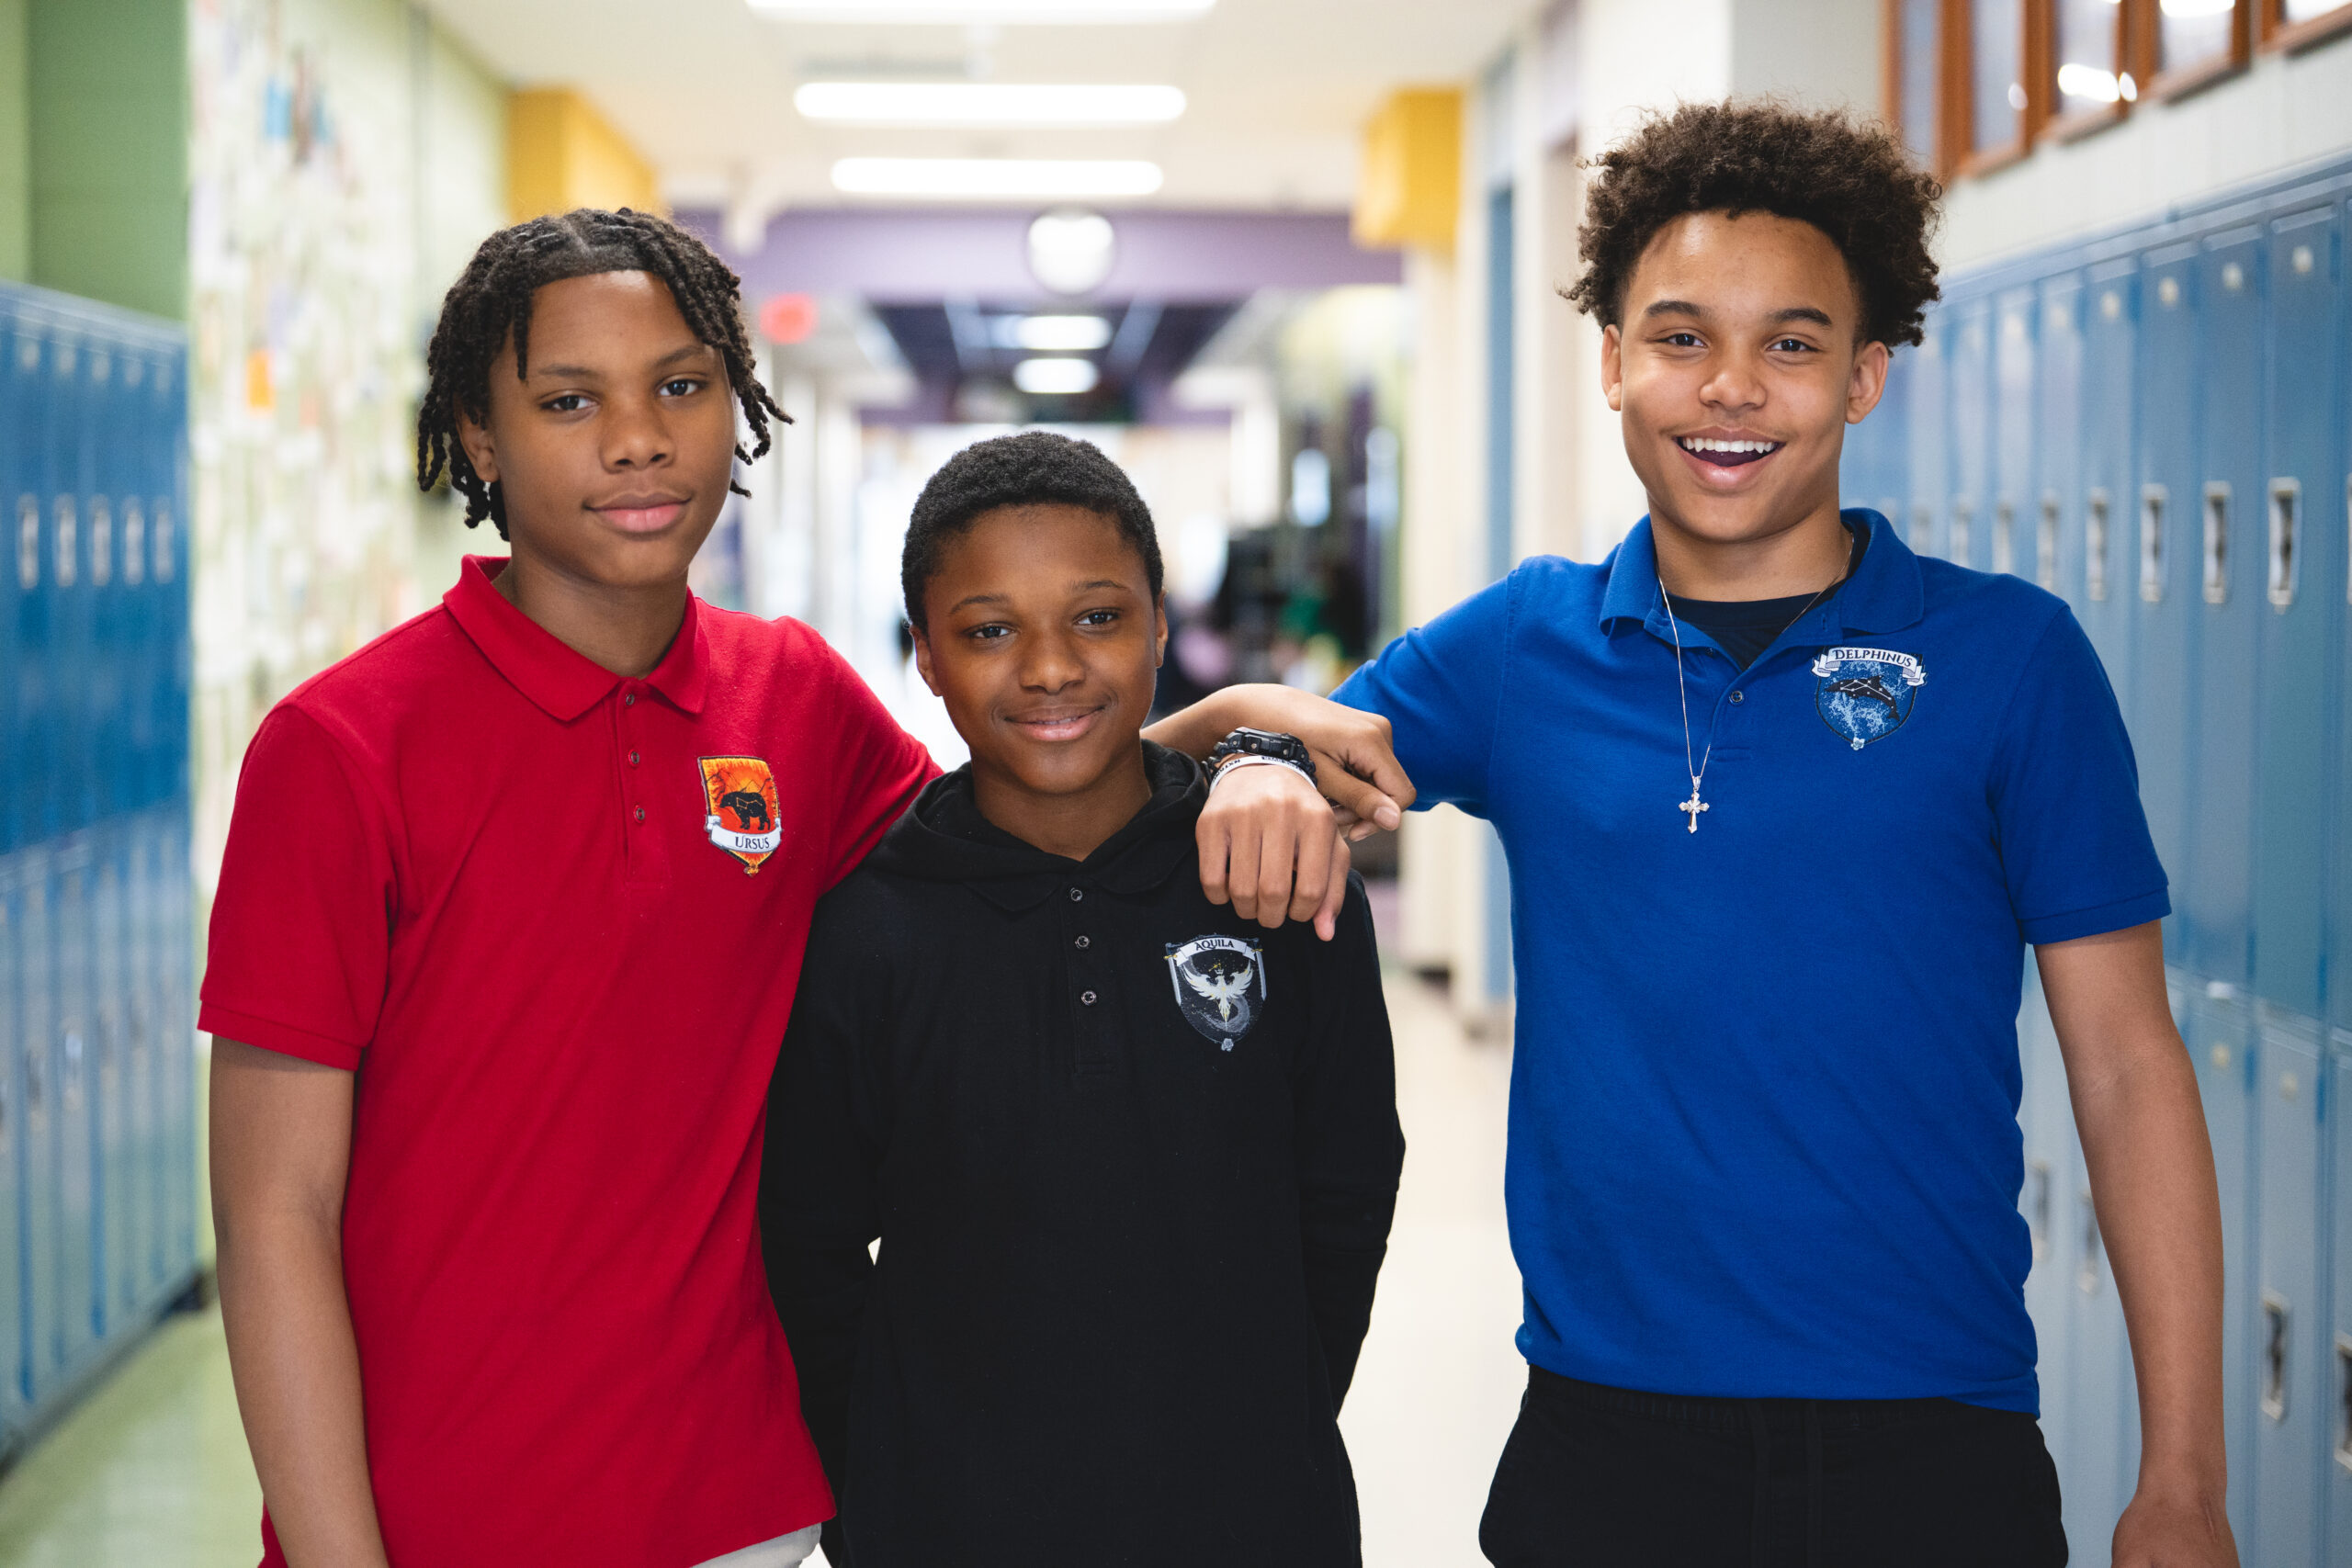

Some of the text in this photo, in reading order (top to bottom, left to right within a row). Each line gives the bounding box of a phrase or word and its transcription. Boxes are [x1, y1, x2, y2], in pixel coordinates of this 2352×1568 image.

[1832, 649, 1913, 667] DELPHINUS
[735, 835, 770, 850] URSUS
[1194, 939, 1235, 951] AQUILA
